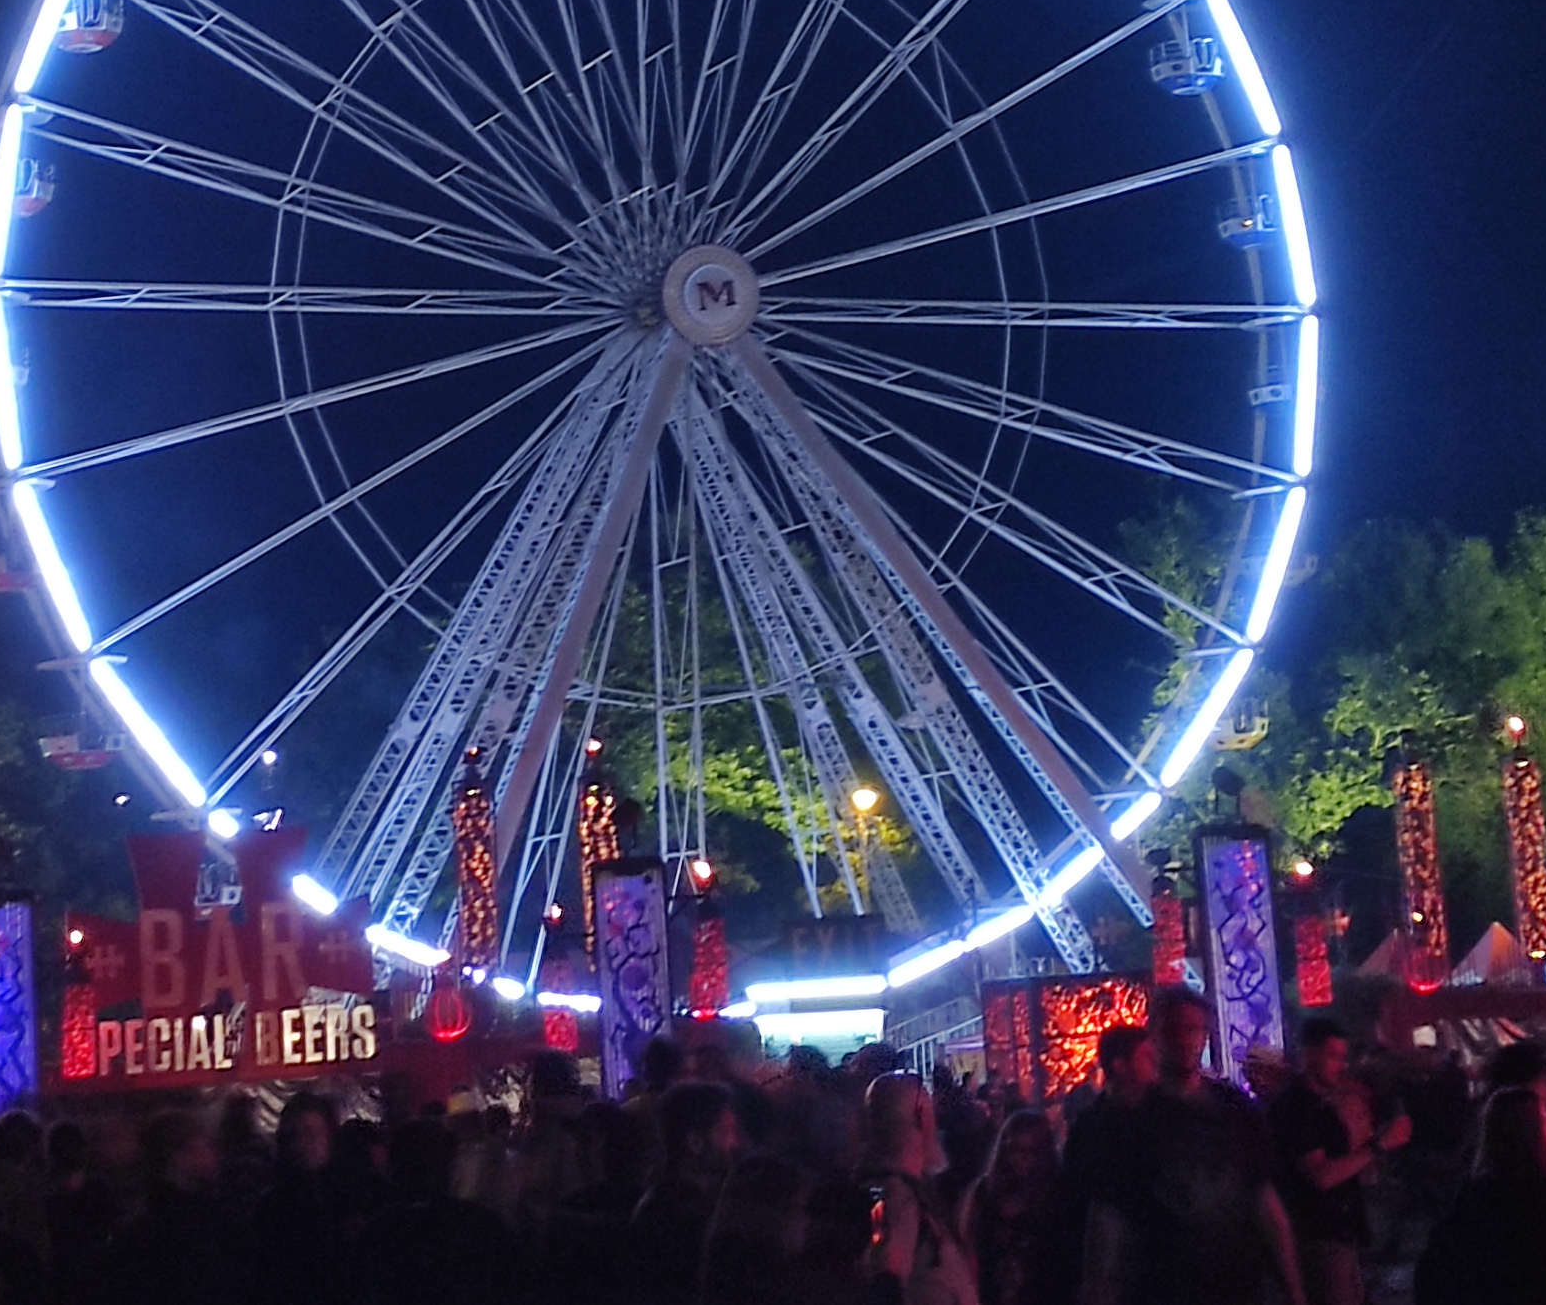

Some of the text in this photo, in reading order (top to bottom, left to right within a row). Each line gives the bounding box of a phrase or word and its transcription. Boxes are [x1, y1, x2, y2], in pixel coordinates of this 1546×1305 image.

[696, 279, 737, 312] M
[139, 901, 310, 1009] BAR
[95, 1003, 379, 1077] PECIAL BEERS
